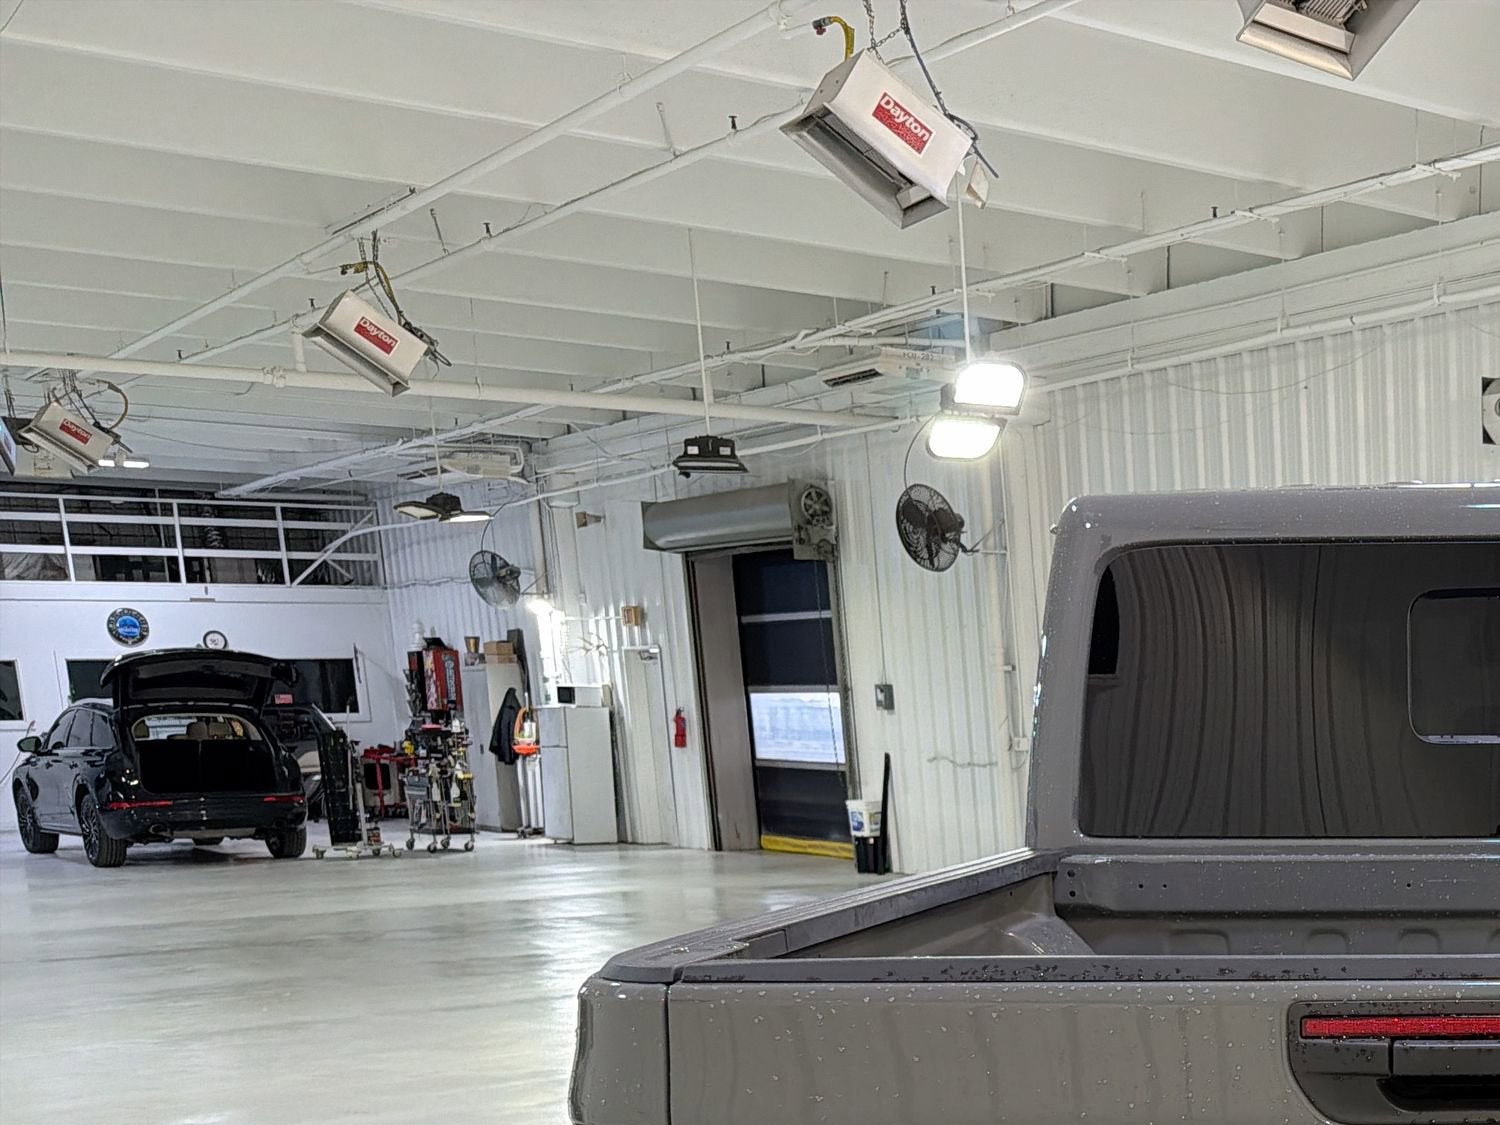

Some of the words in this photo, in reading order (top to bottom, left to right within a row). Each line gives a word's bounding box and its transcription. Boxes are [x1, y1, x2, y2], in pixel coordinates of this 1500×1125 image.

[880, 95, 930, 141] Dayton
[360, 318, 396, 347] Dayton
[63, 419, 91, 439] Dayton
